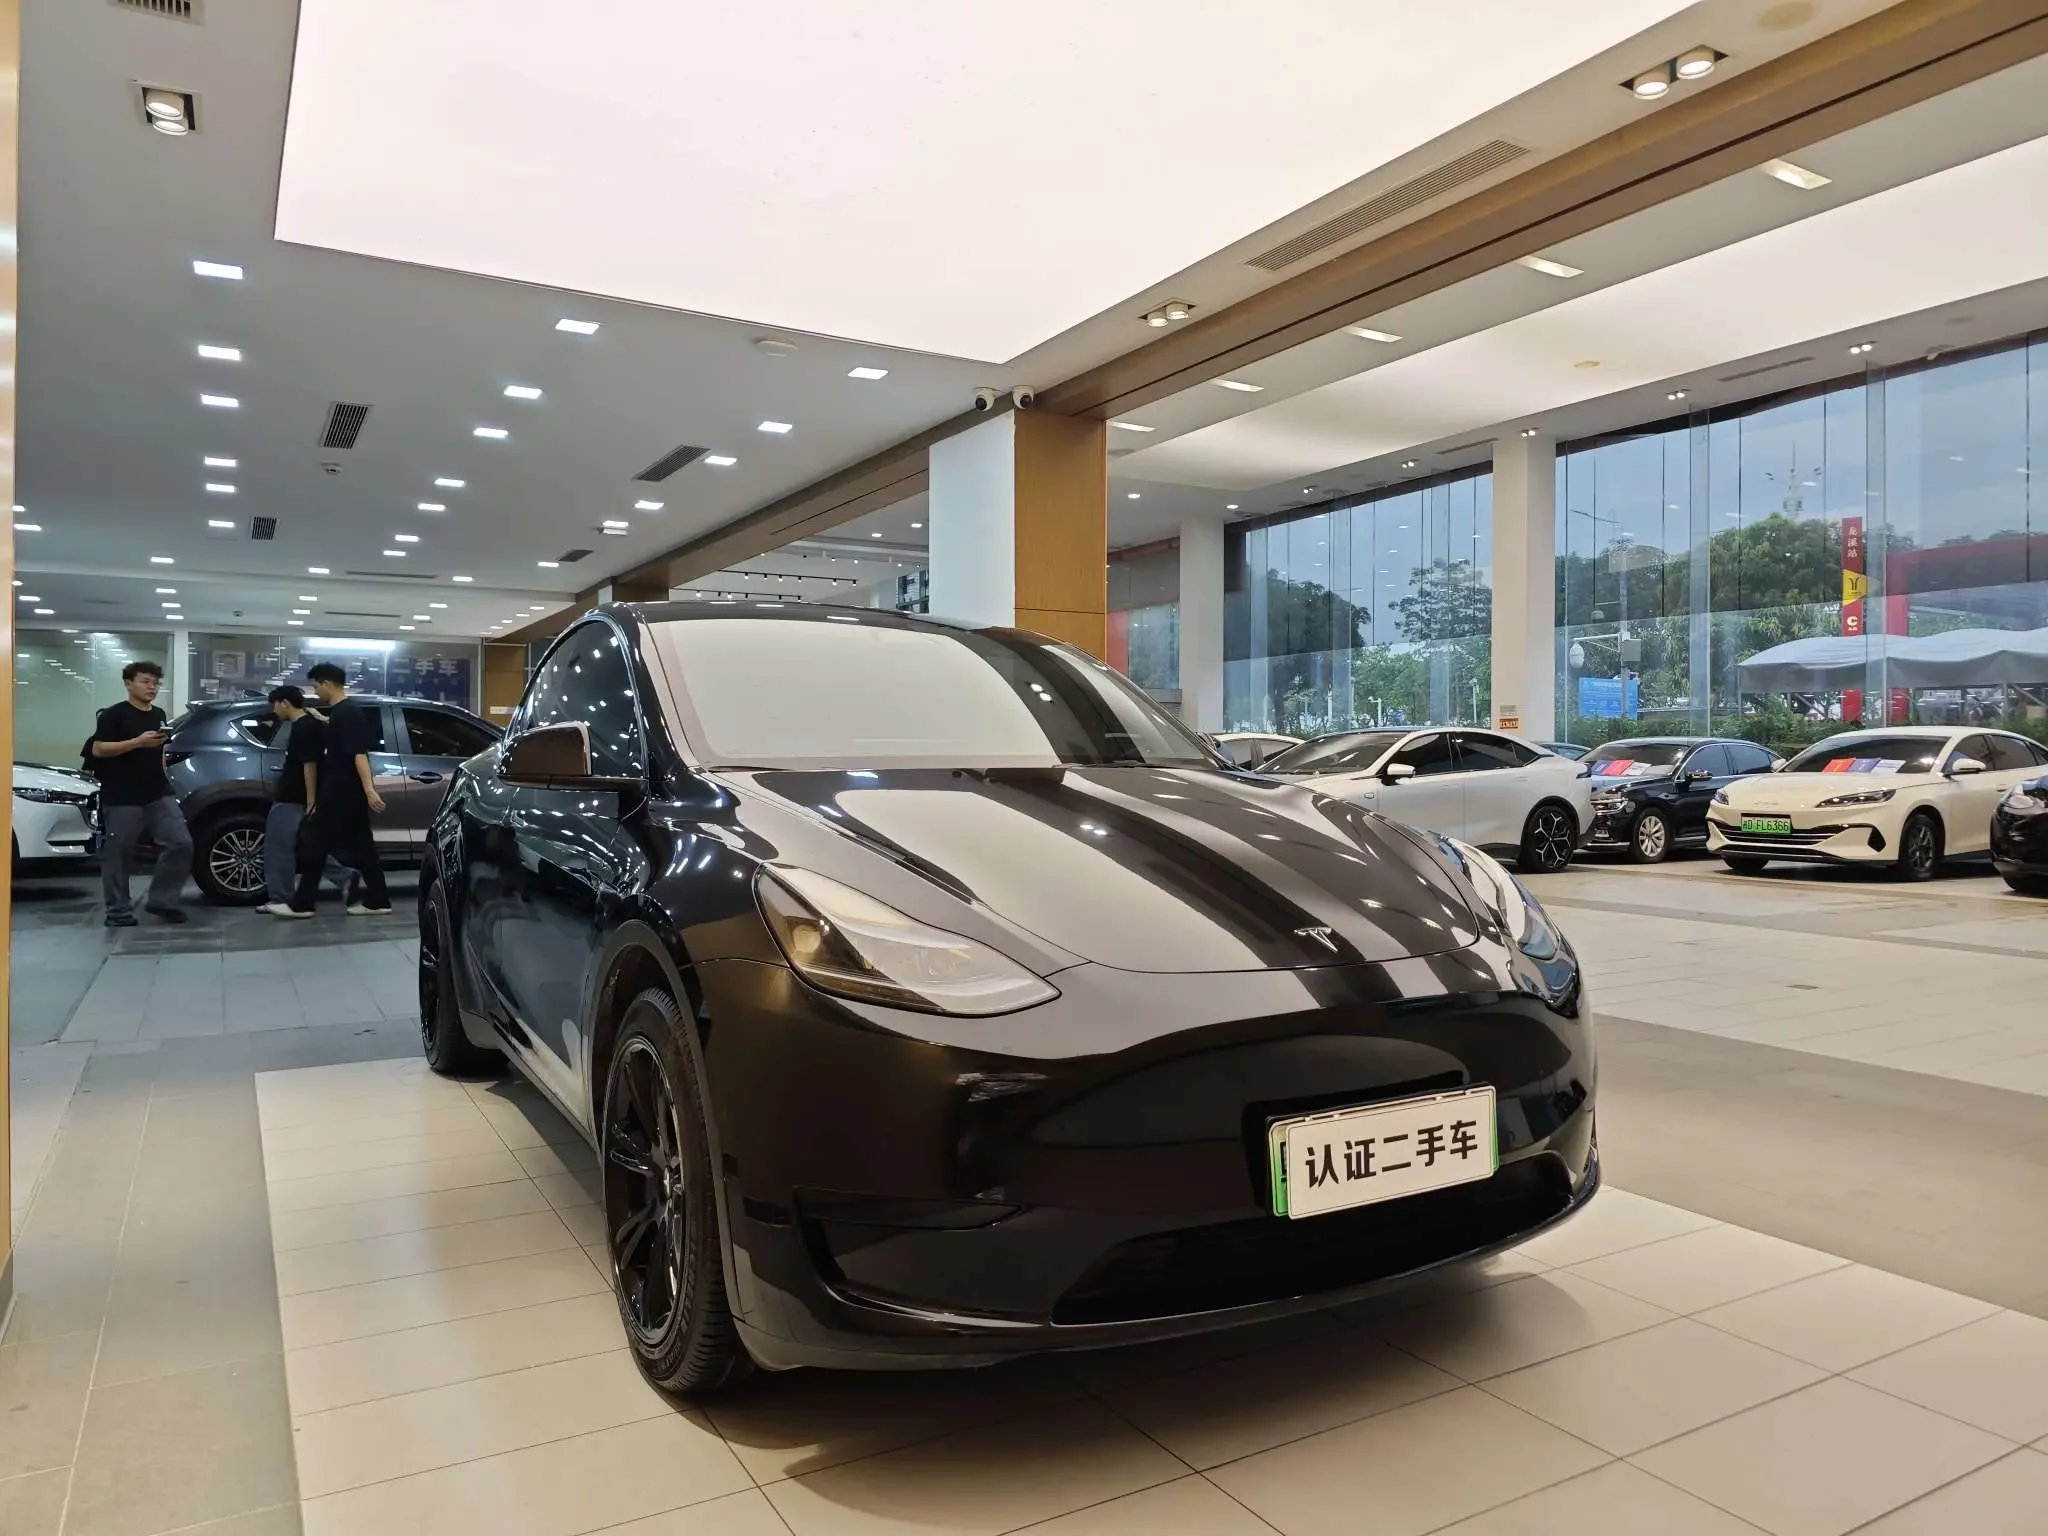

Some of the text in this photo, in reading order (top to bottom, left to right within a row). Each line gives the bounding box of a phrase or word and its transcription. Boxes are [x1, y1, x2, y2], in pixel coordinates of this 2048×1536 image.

[1847, 616, 1858, 626] C
[1757, 820, 1789, 832] FL6366
[1305, 1119, 1478, 1188] 认证二手车
